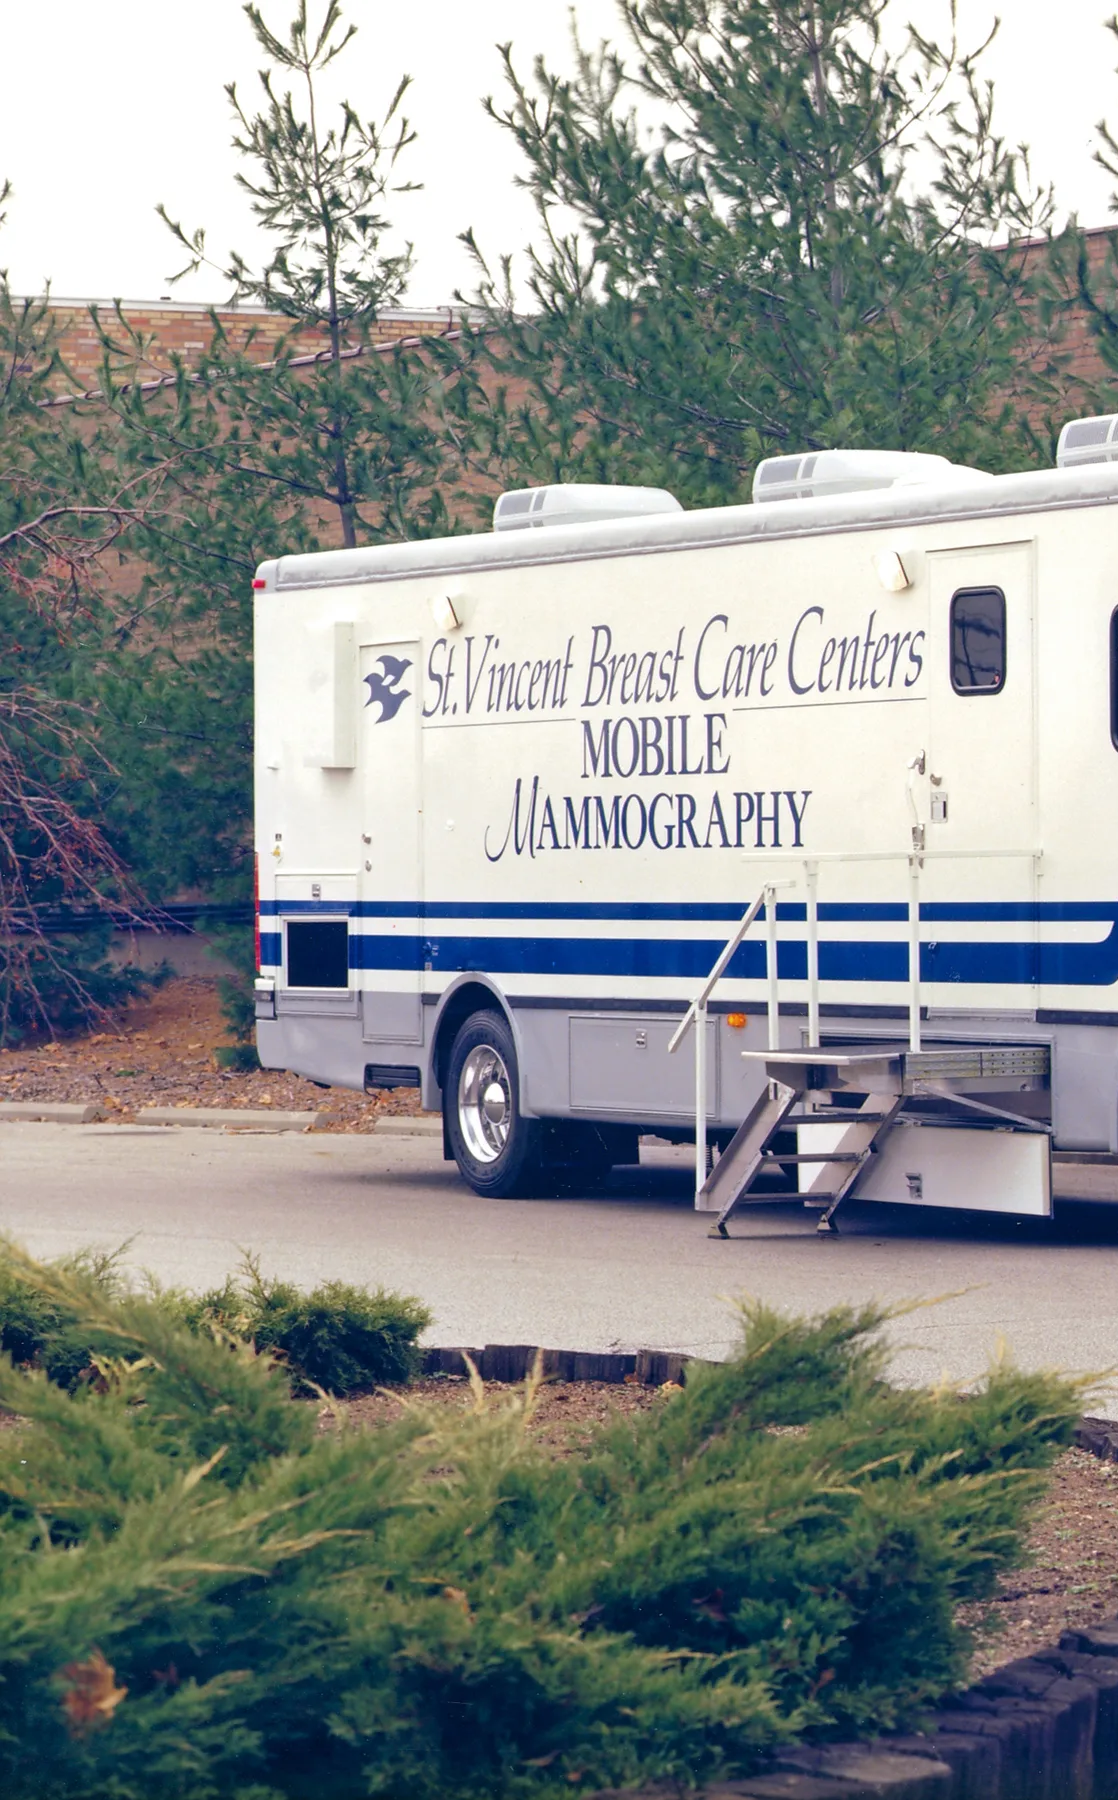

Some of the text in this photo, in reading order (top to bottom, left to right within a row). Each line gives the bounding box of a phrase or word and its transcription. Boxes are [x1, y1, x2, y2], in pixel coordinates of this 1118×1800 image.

[580, 624, 686, 708] Breast
[694, 613, 778, 702] Care
[788, 606, 925, 696] Centers
[581, 713, 731, 779] MOBILE
[484, 777, 813, 862] MAMMOGRAPHY
